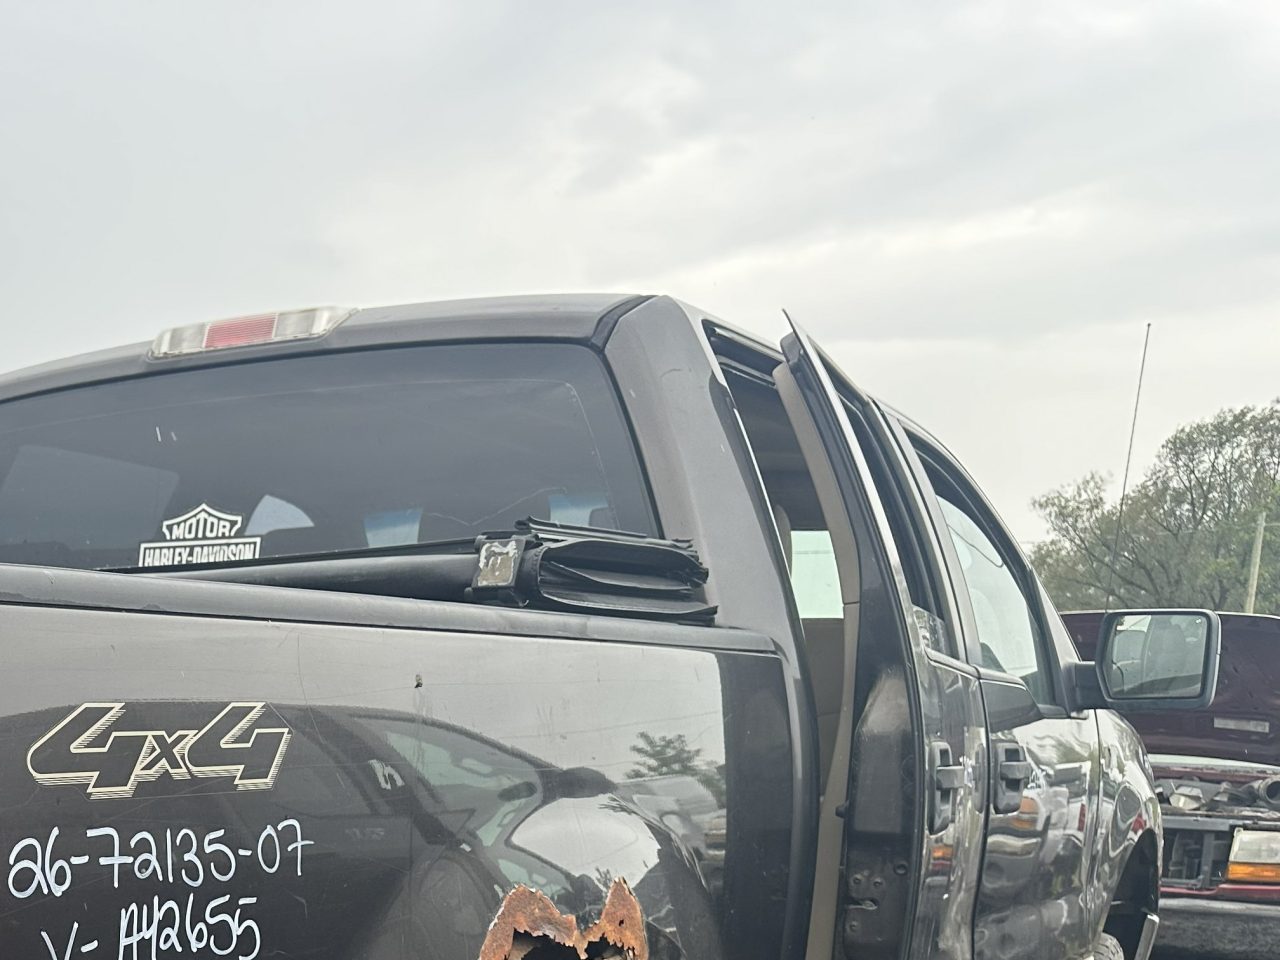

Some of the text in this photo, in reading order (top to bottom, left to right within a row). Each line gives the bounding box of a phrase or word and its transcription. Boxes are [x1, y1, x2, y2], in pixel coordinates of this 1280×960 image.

[172, 511, 231, 540] MOTOR
[144, 543, 255, 567] HARLEY-DAVIDSON
[7, 818, 316, 899] 26-72135-07
